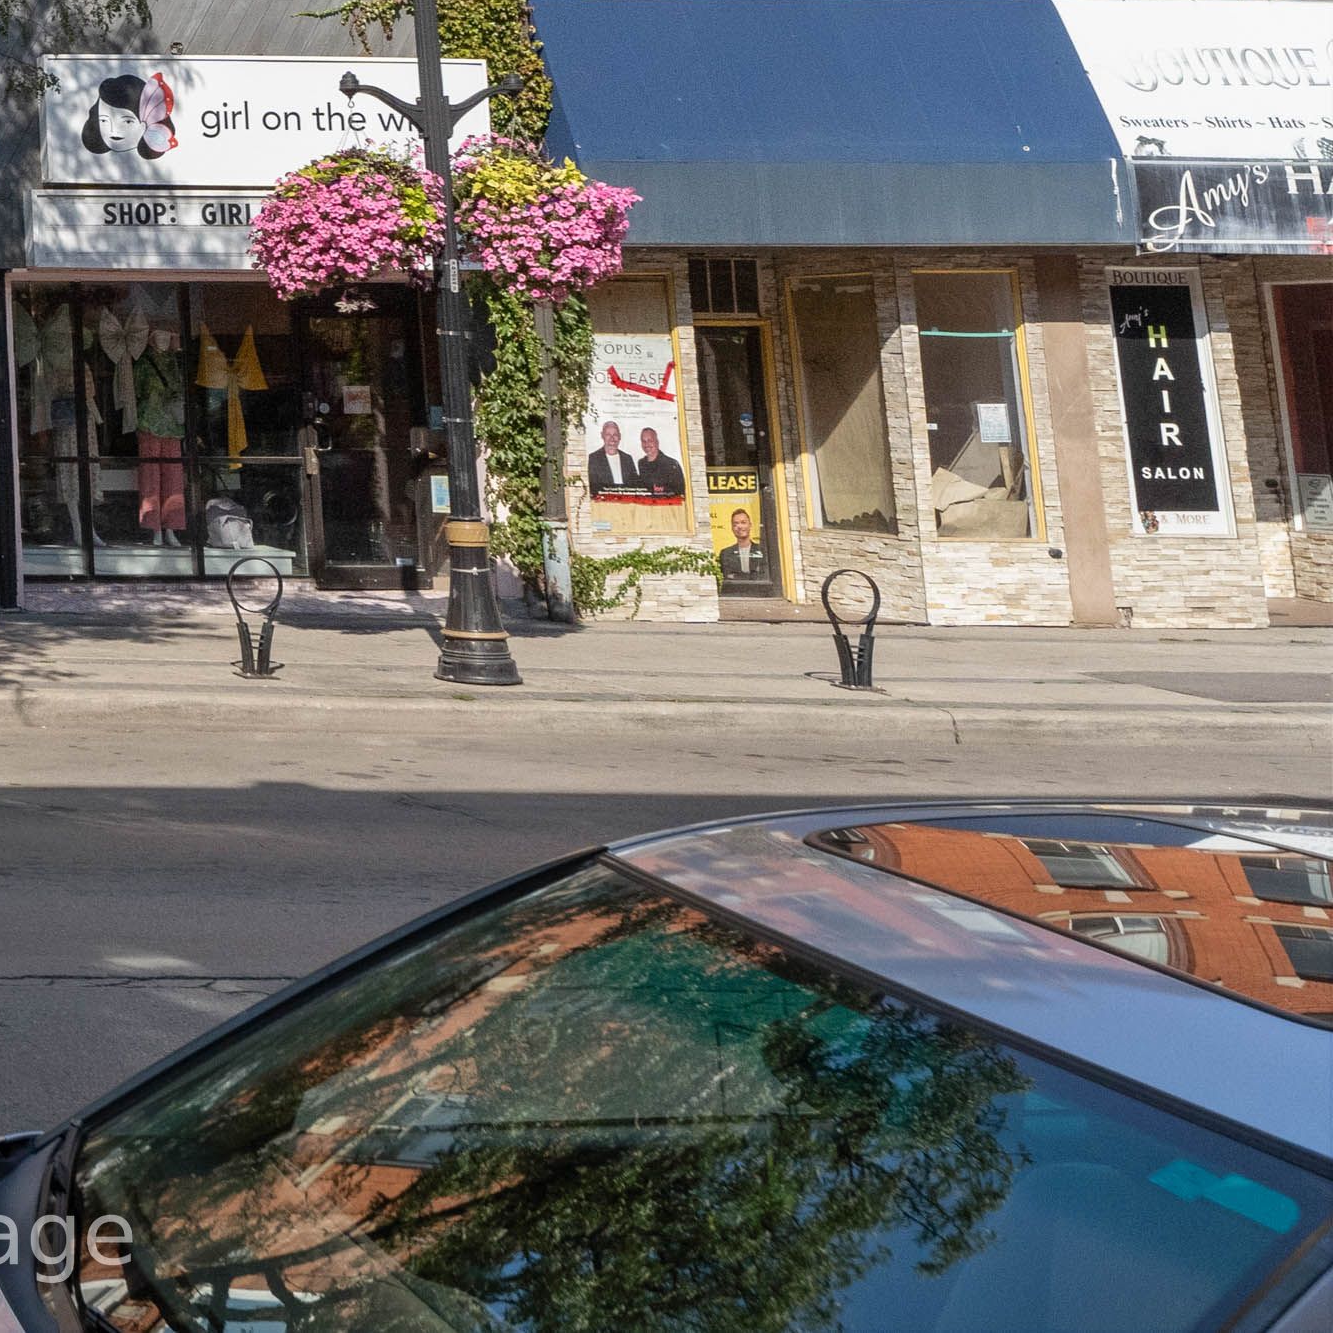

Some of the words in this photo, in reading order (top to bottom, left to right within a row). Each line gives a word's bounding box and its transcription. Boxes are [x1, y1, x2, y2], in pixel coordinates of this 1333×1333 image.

[201, 100, 249, 138] girl
[262, 111, 302, 131] on
[312, 102, 367, 131] the
[1119, 116, 1189, 129] Sweaters
[1205, 116, 1253, 129] Shirts
[1268, 116, 1306, 129] Hats
[103, 202, 177, 226] SHOP:
[1145, 164, 1269, 254] Amy's
[1113, 270, 1187, 285] BOUTIQUE
[604, 344, 642, 356] OPUS
[1147, 324, 1183, 447] HAIR
[1141, 467, 1205, 479] SALON
[709, 475, 756, 491] LEASE
